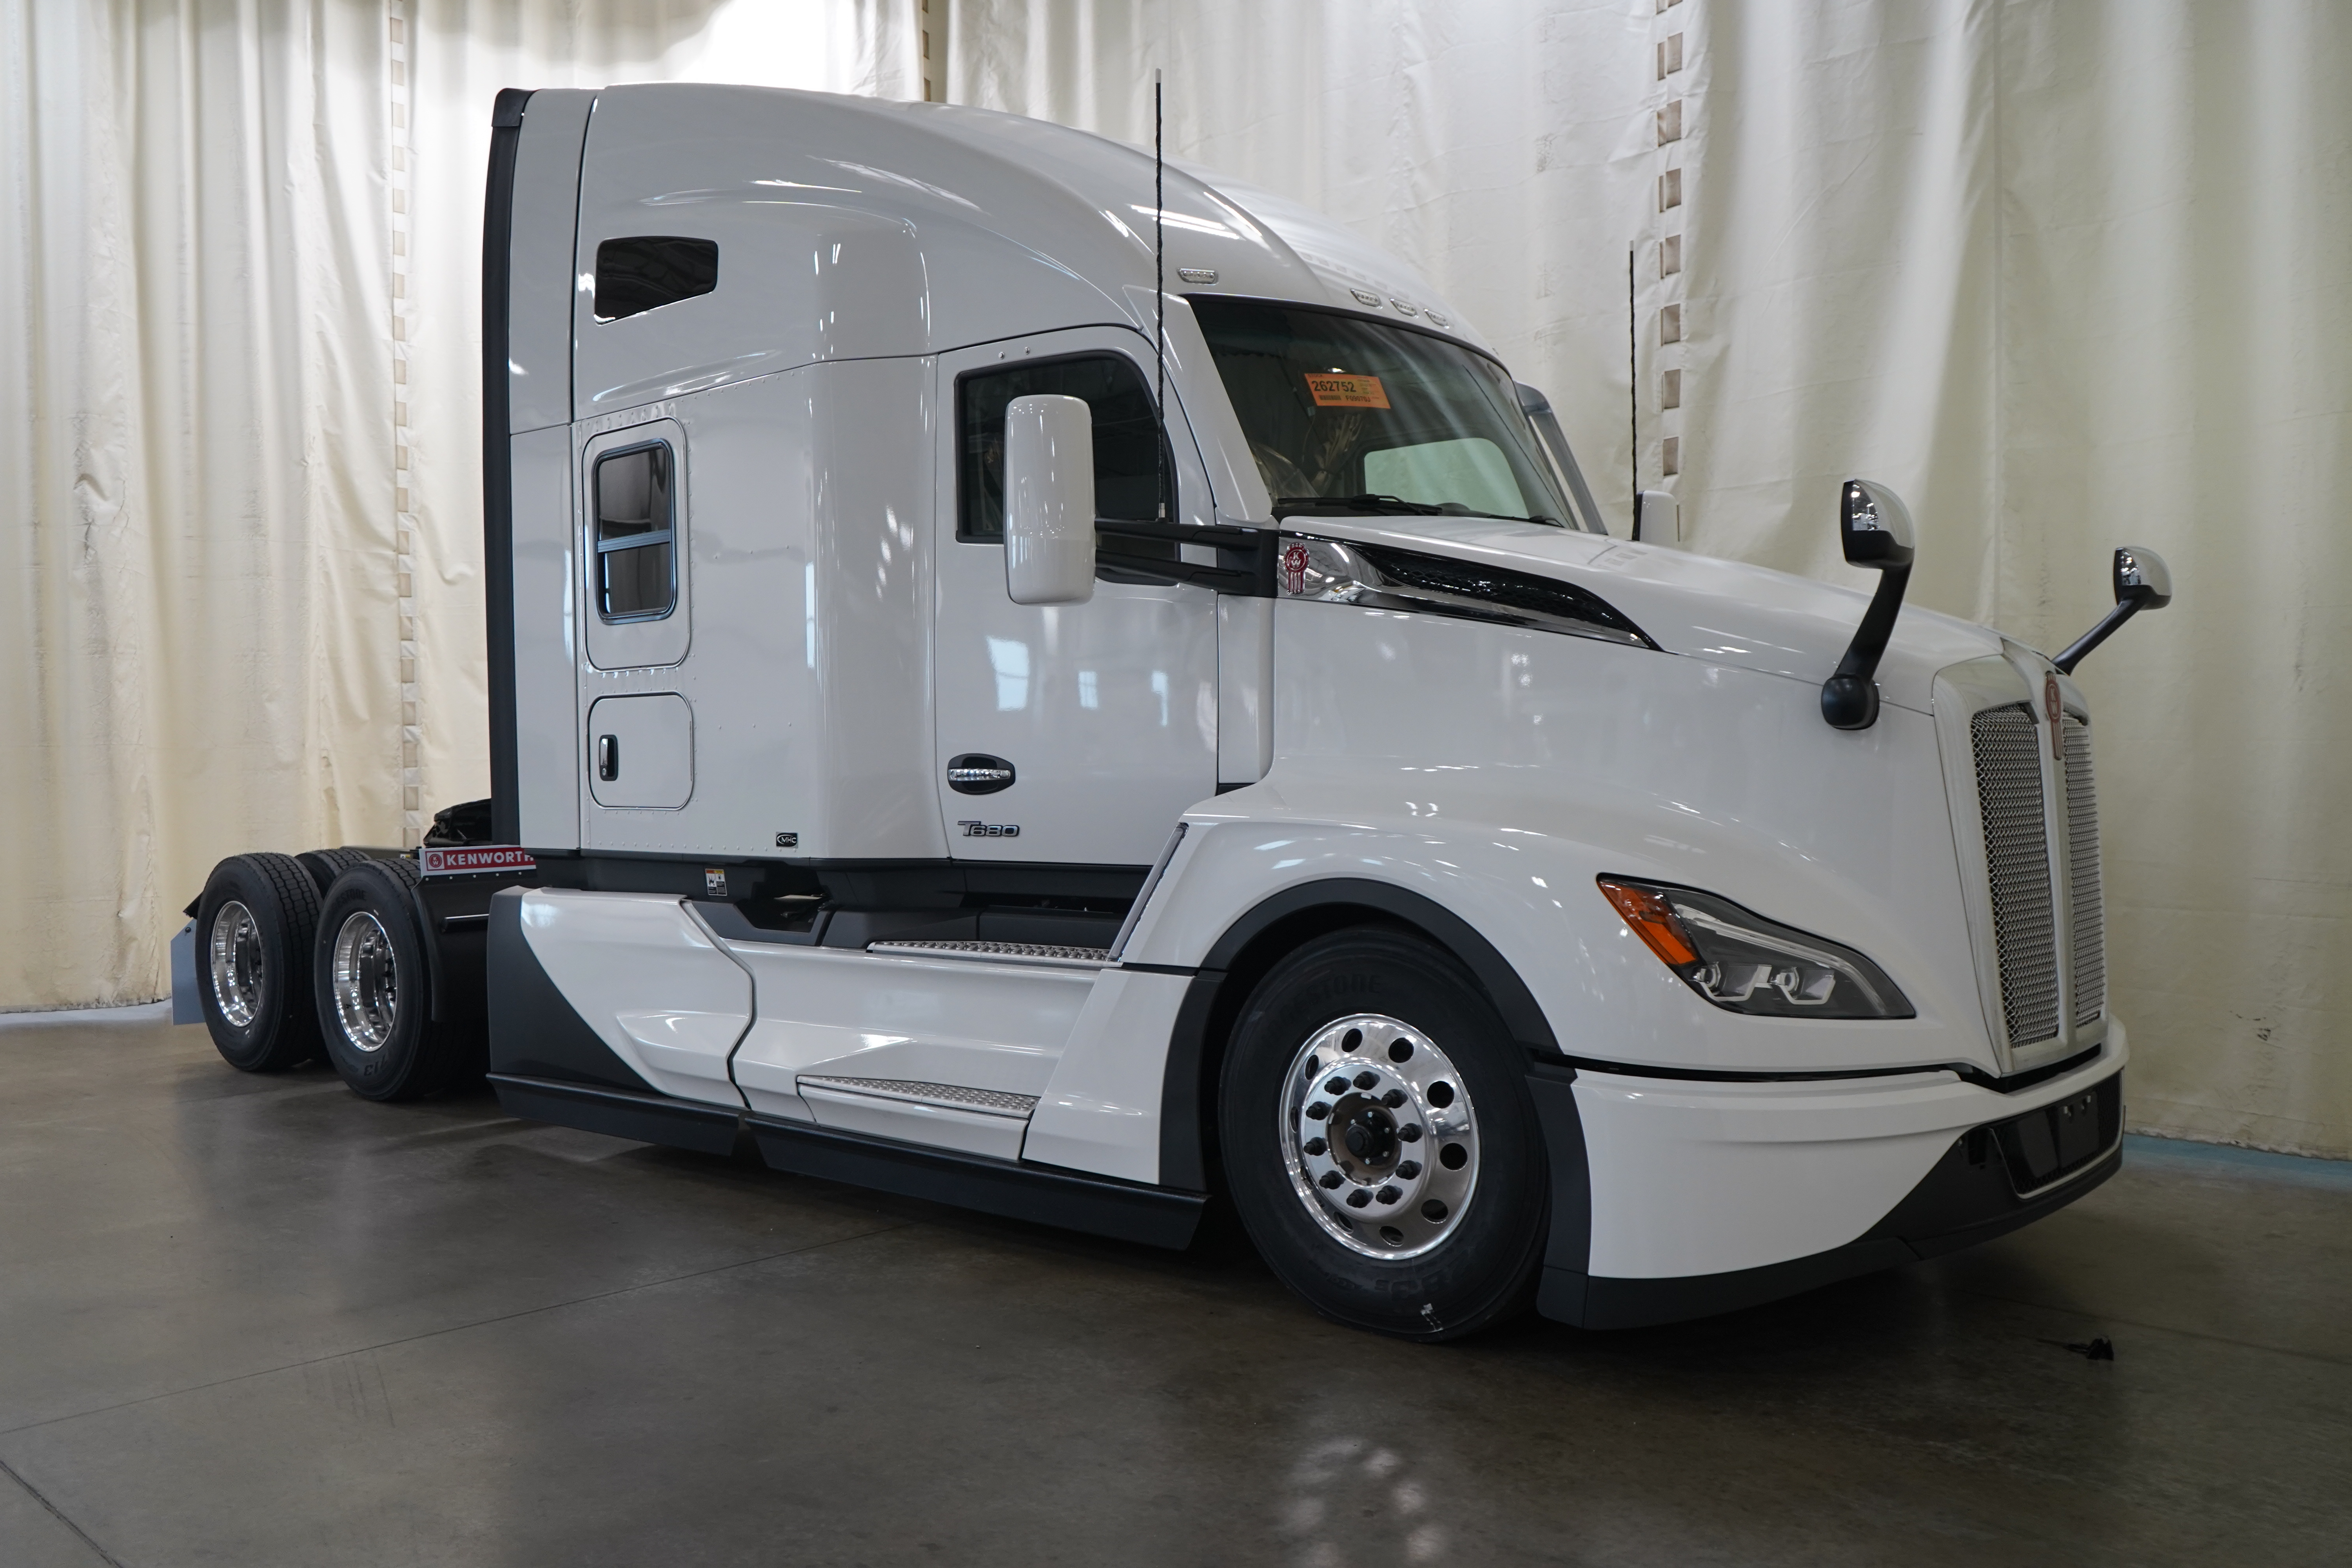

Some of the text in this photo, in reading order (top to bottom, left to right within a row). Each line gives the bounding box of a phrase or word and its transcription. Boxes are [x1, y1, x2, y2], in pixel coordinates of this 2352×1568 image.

[1312, 380, 1356, 392] 262752
[957, 821, 1020, 837] T680
[446, 851, 534, 866] KENWORTH
